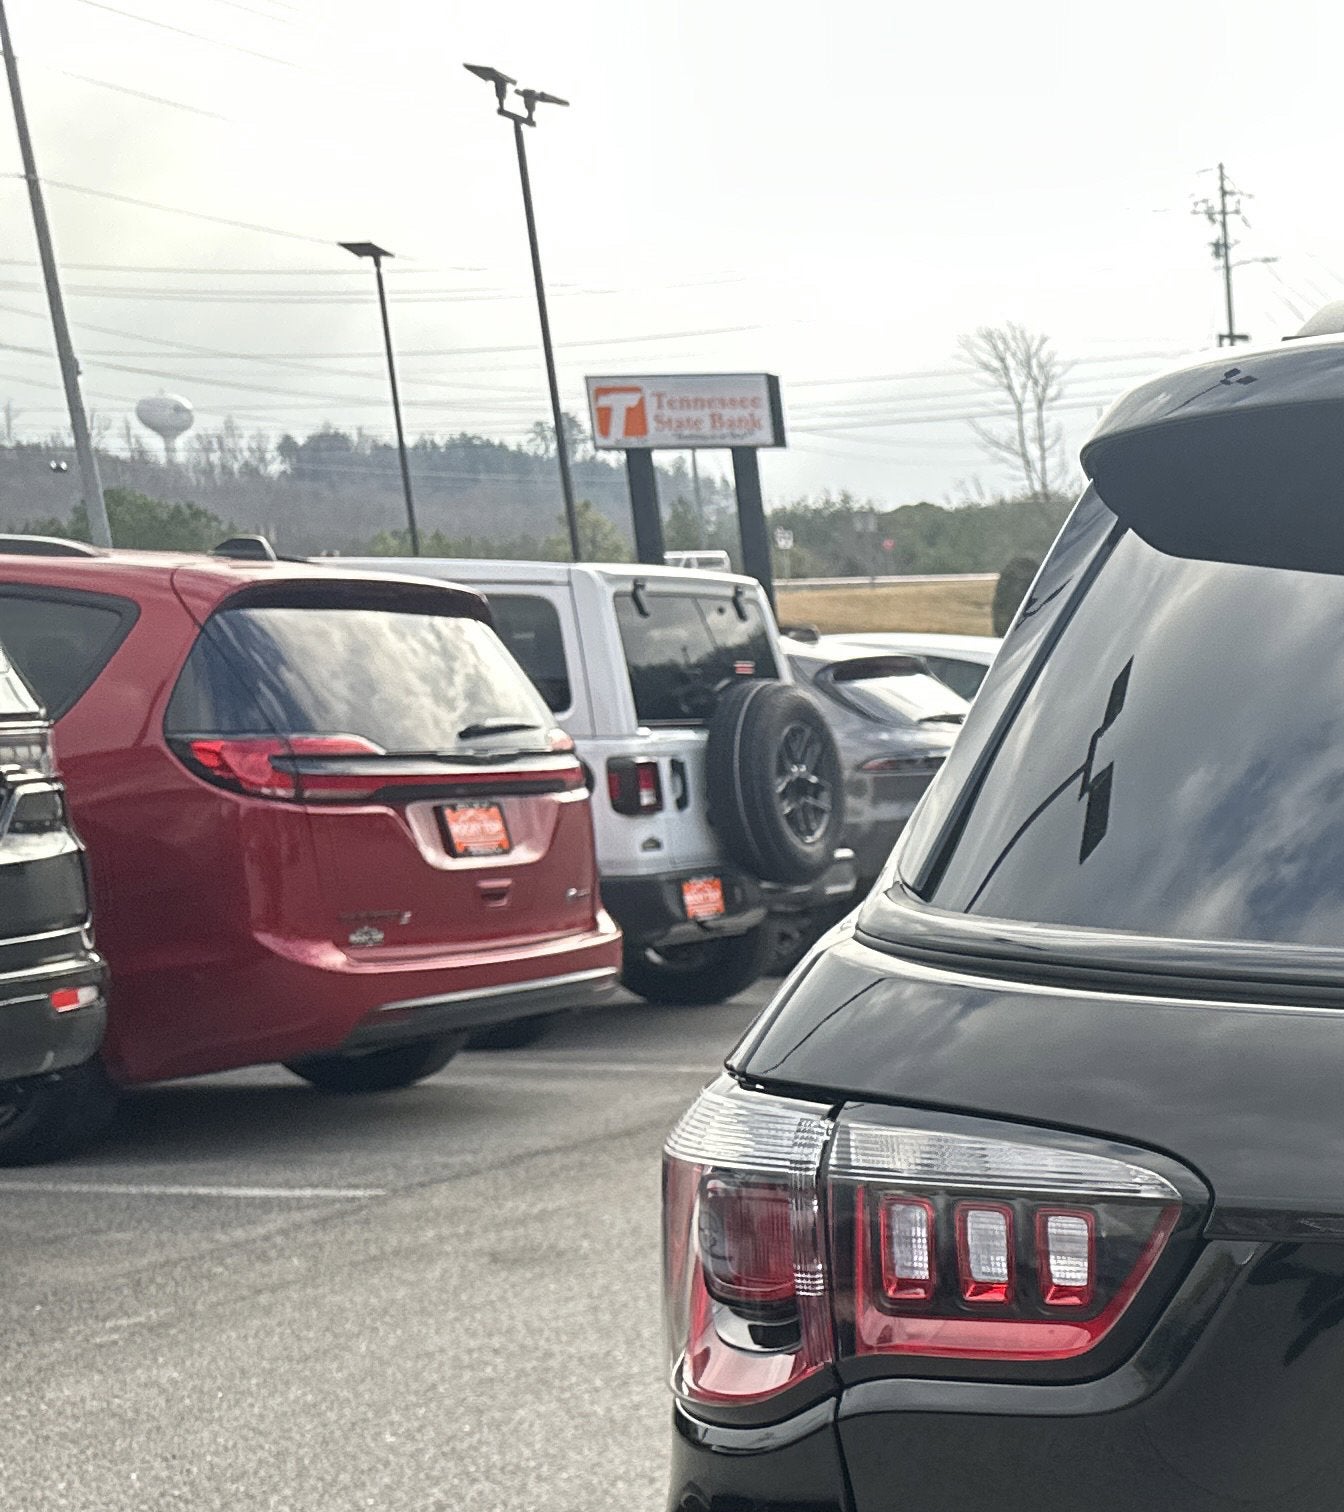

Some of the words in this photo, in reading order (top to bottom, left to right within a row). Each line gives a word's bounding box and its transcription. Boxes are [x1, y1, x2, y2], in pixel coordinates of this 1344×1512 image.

[651, 391, 761, 410] Tennessee
[653, 414, 703, 431] State
[709, 412, 762, 430] Bank
